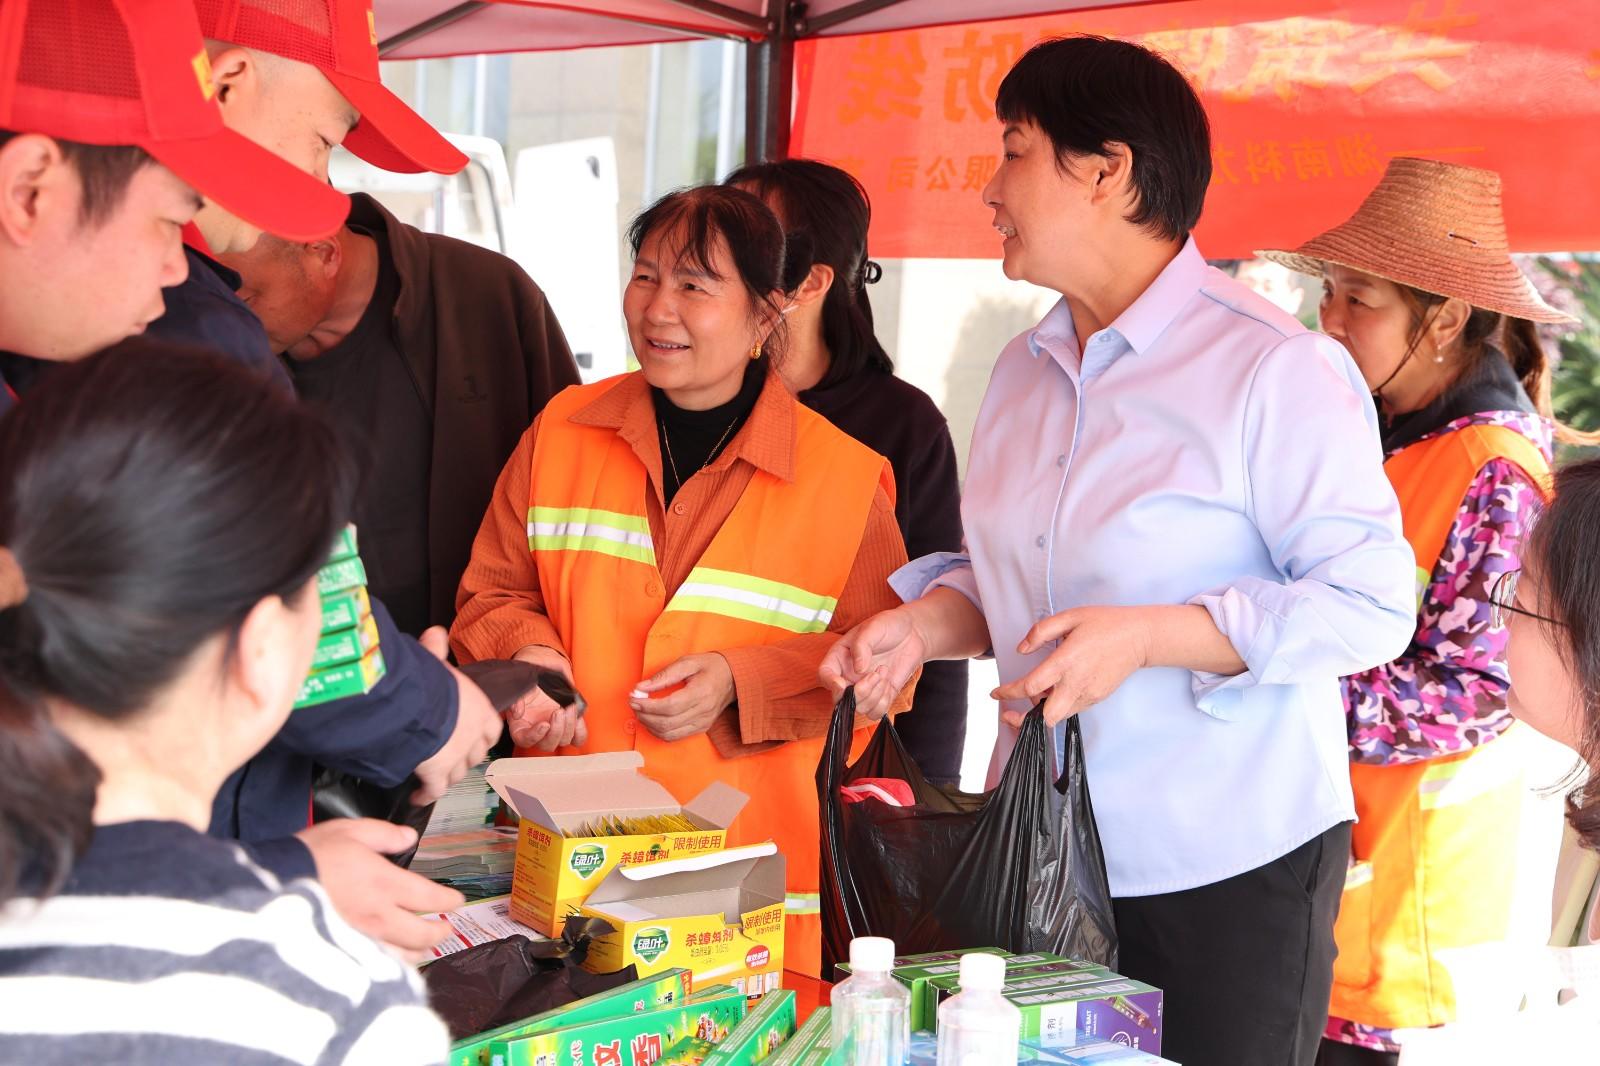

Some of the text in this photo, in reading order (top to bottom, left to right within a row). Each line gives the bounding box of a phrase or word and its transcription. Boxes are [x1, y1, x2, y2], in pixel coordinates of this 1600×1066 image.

[674, 835, 722, 851] 限制使用
[574, 854, 600, 867] 绿叶
[744, 909, 782, 930] 限制使用
[637, 937, 664, 950] 绿叶
